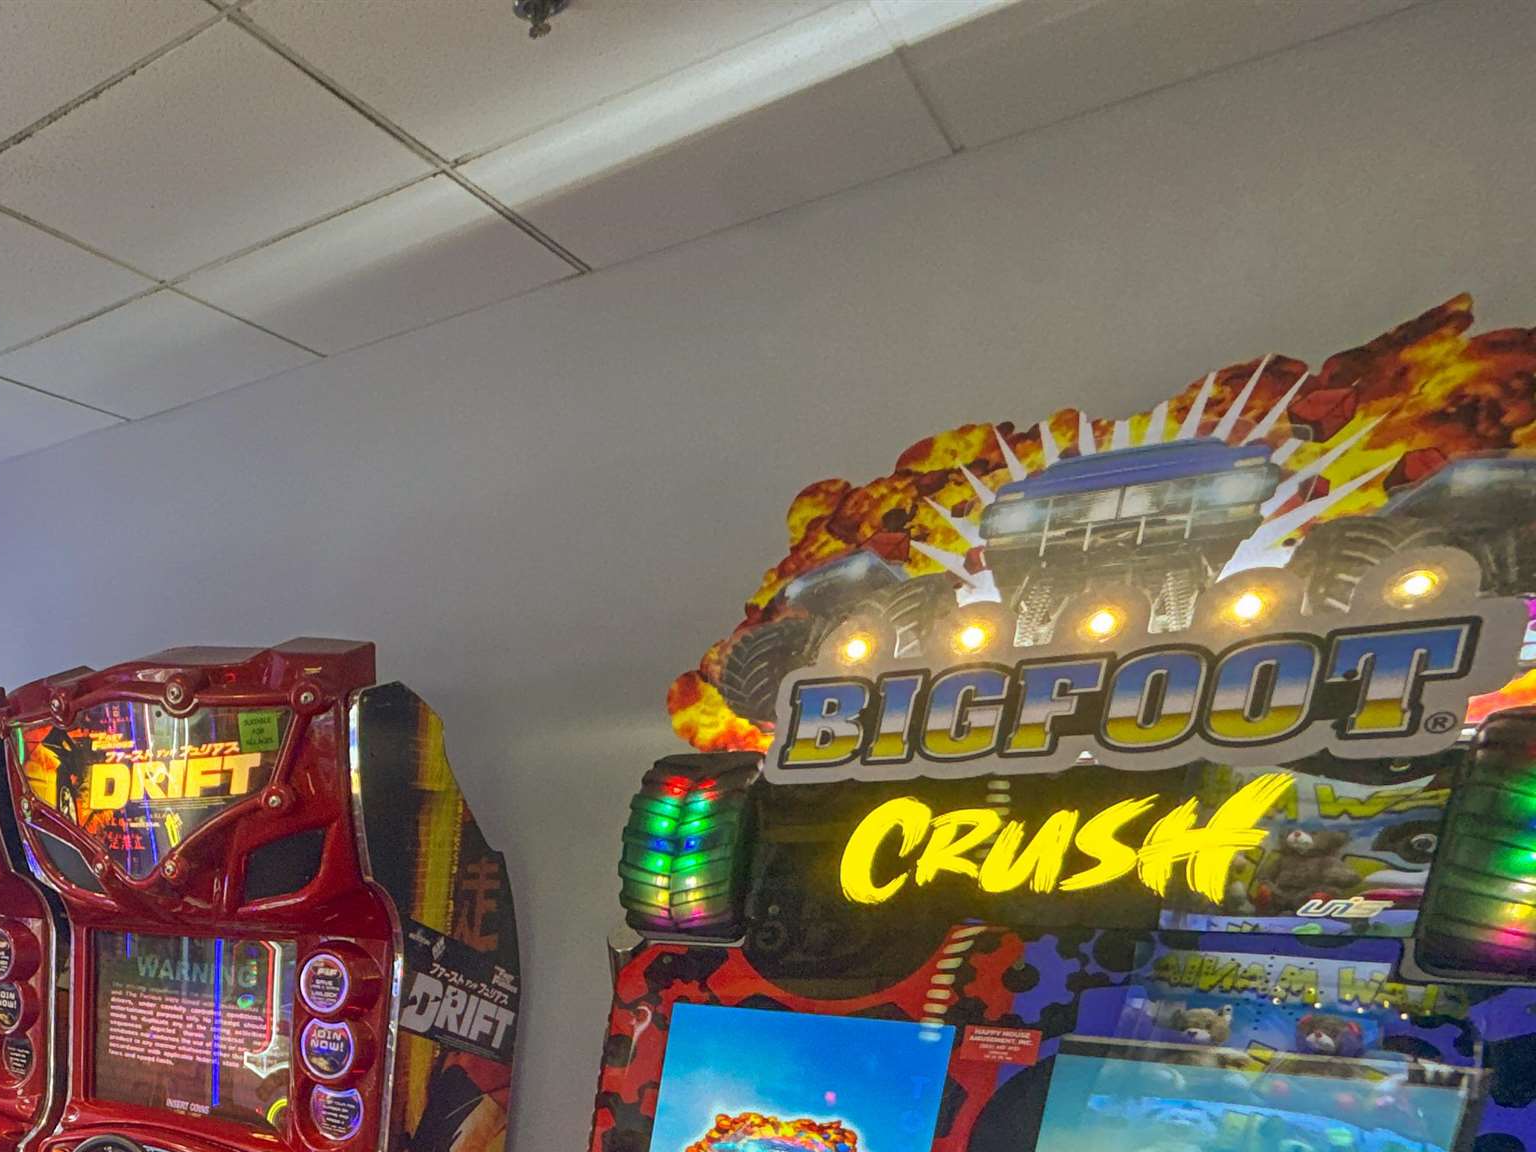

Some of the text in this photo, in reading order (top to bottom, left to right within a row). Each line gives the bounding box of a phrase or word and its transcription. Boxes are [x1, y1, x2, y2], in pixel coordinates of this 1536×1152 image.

[777, 616, 1481, 769] BIGFOOT
[90, 752, 262, 810] DRIFT
[840, 772, 1296, 905] CRUSH
[136, 953, 260, 991] WARNING
[313, 1028, 342, 1042] JOIN
[399, 971, 516, 1049] DRIFT
[310, 1038, 345, 1052] NOW!
